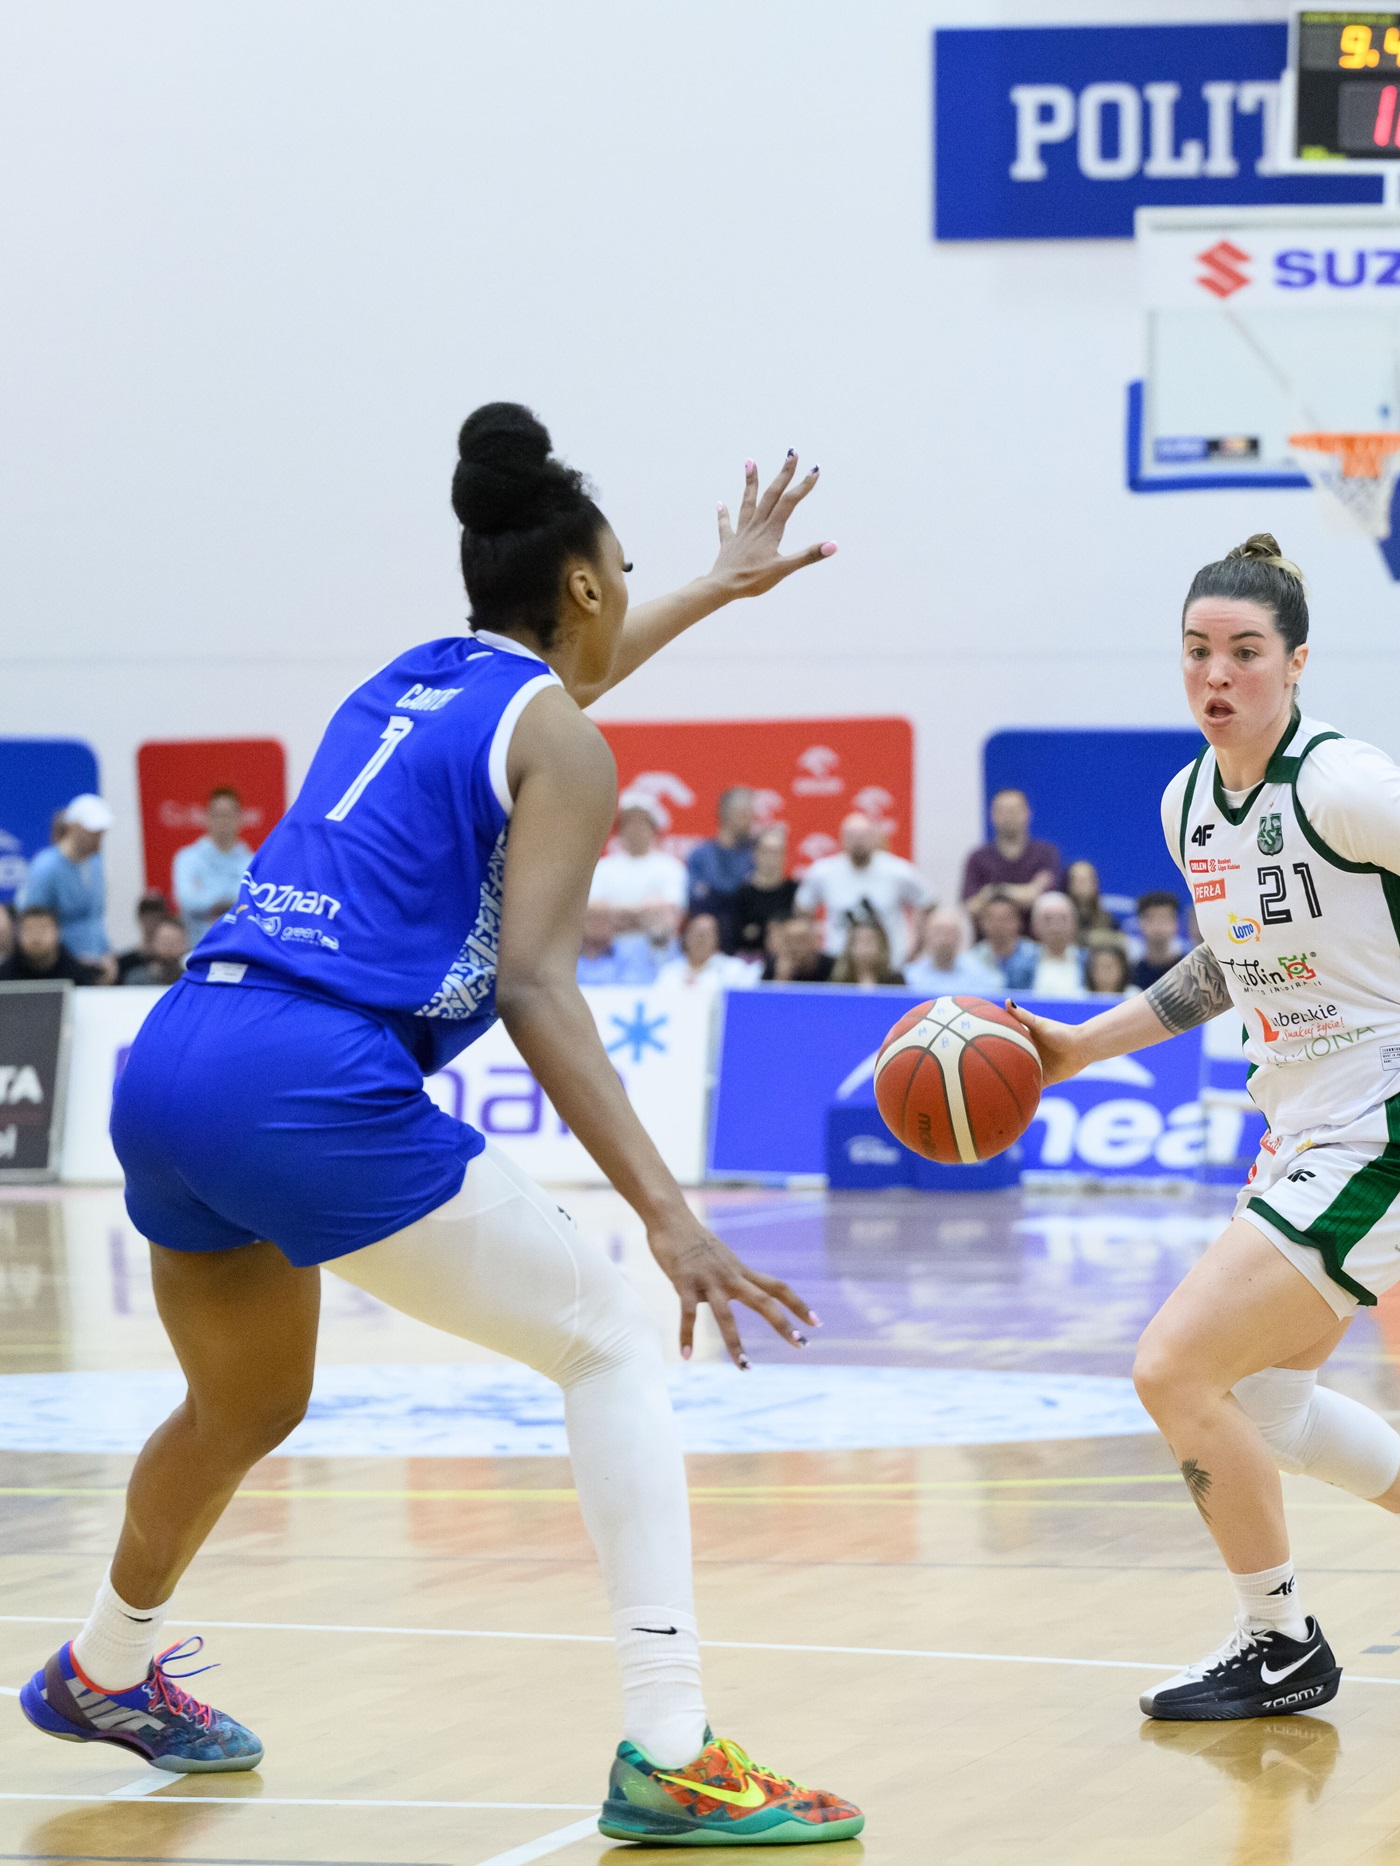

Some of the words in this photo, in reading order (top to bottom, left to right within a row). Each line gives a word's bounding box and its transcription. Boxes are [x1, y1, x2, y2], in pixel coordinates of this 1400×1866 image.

[325, 715, 414, 821] 7
[1191, 824, 1215, 846] 4F
[1191, 862, 1207, 871] ORLEN
[1195, 883, 1222, 899] PERŁA
[1257, 862, 1322, 925] 21
[1038, 1098, 1247, 1168] nea
